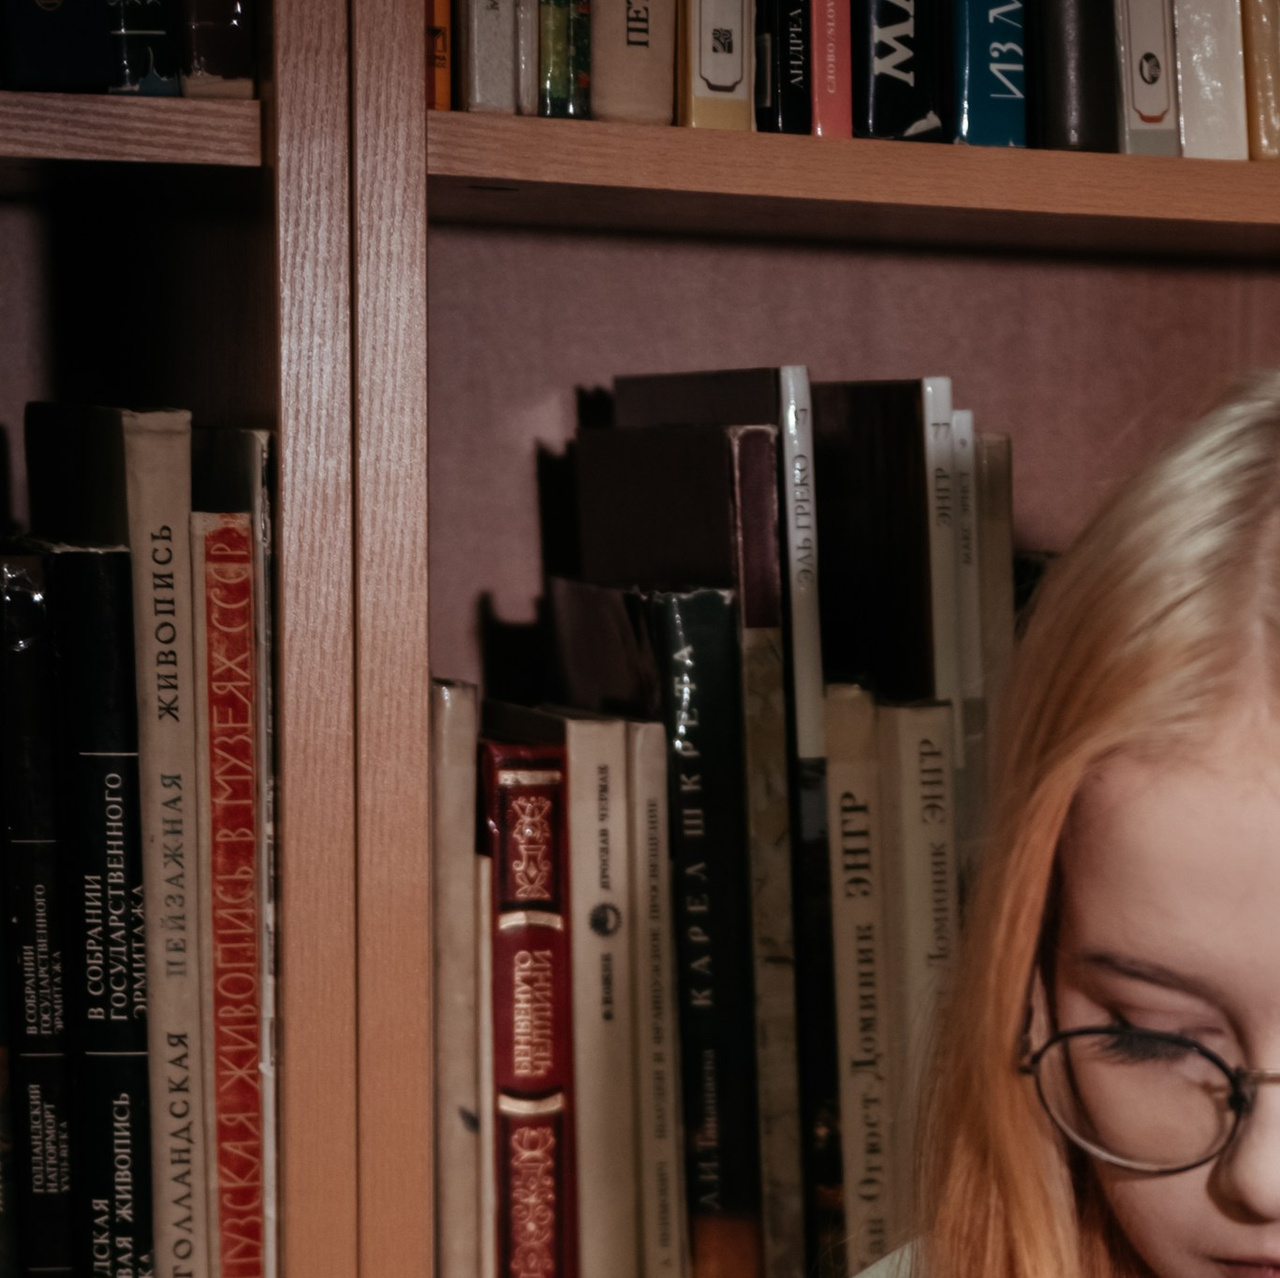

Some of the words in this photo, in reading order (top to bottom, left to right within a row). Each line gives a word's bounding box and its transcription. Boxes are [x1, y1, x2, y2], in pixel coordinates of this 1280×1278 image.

[988, 41, 1025, 98] ИЗ
[150, 524, 180, 723] ЖИВОПИСЬ
[209, 542, 250, 635] СССР
[796, 538, 814, 584] ЭЛЬ
[211, 651, 254, 804] МУЗЕЯХ
[918, 738, 946, 824] ЭНГР
[103, 771, 129, 1022] ГОСУДАРСТВЕННОГО
[160, 773, 188, 979] ПЕЙЗАЖНАЯ
[215, 826, 255, 843] В
[840, 790, 872, 898] ЭНГР
[34, 883, 53, 1035] ГОСУДАРСТВЕННОГО
[84, 873, 106, 999] СОБРАНИИ
[212, 866, 258, 1093] ЖИВОПИСЬ
[684, 860, 714, 1007] КАРЕЛ
[87, 1006, 106, 1022] В
[514, 949, 533, 1076] БЕНВЕНУТО
[531, 949, 553, 1077] ЧЕЛЛИНИ
[112, 1091, 134, 1223] ЖИВОПИСЬ
[166, 1031, 194, 1278] ГОЛЛАНДСКАЯ
